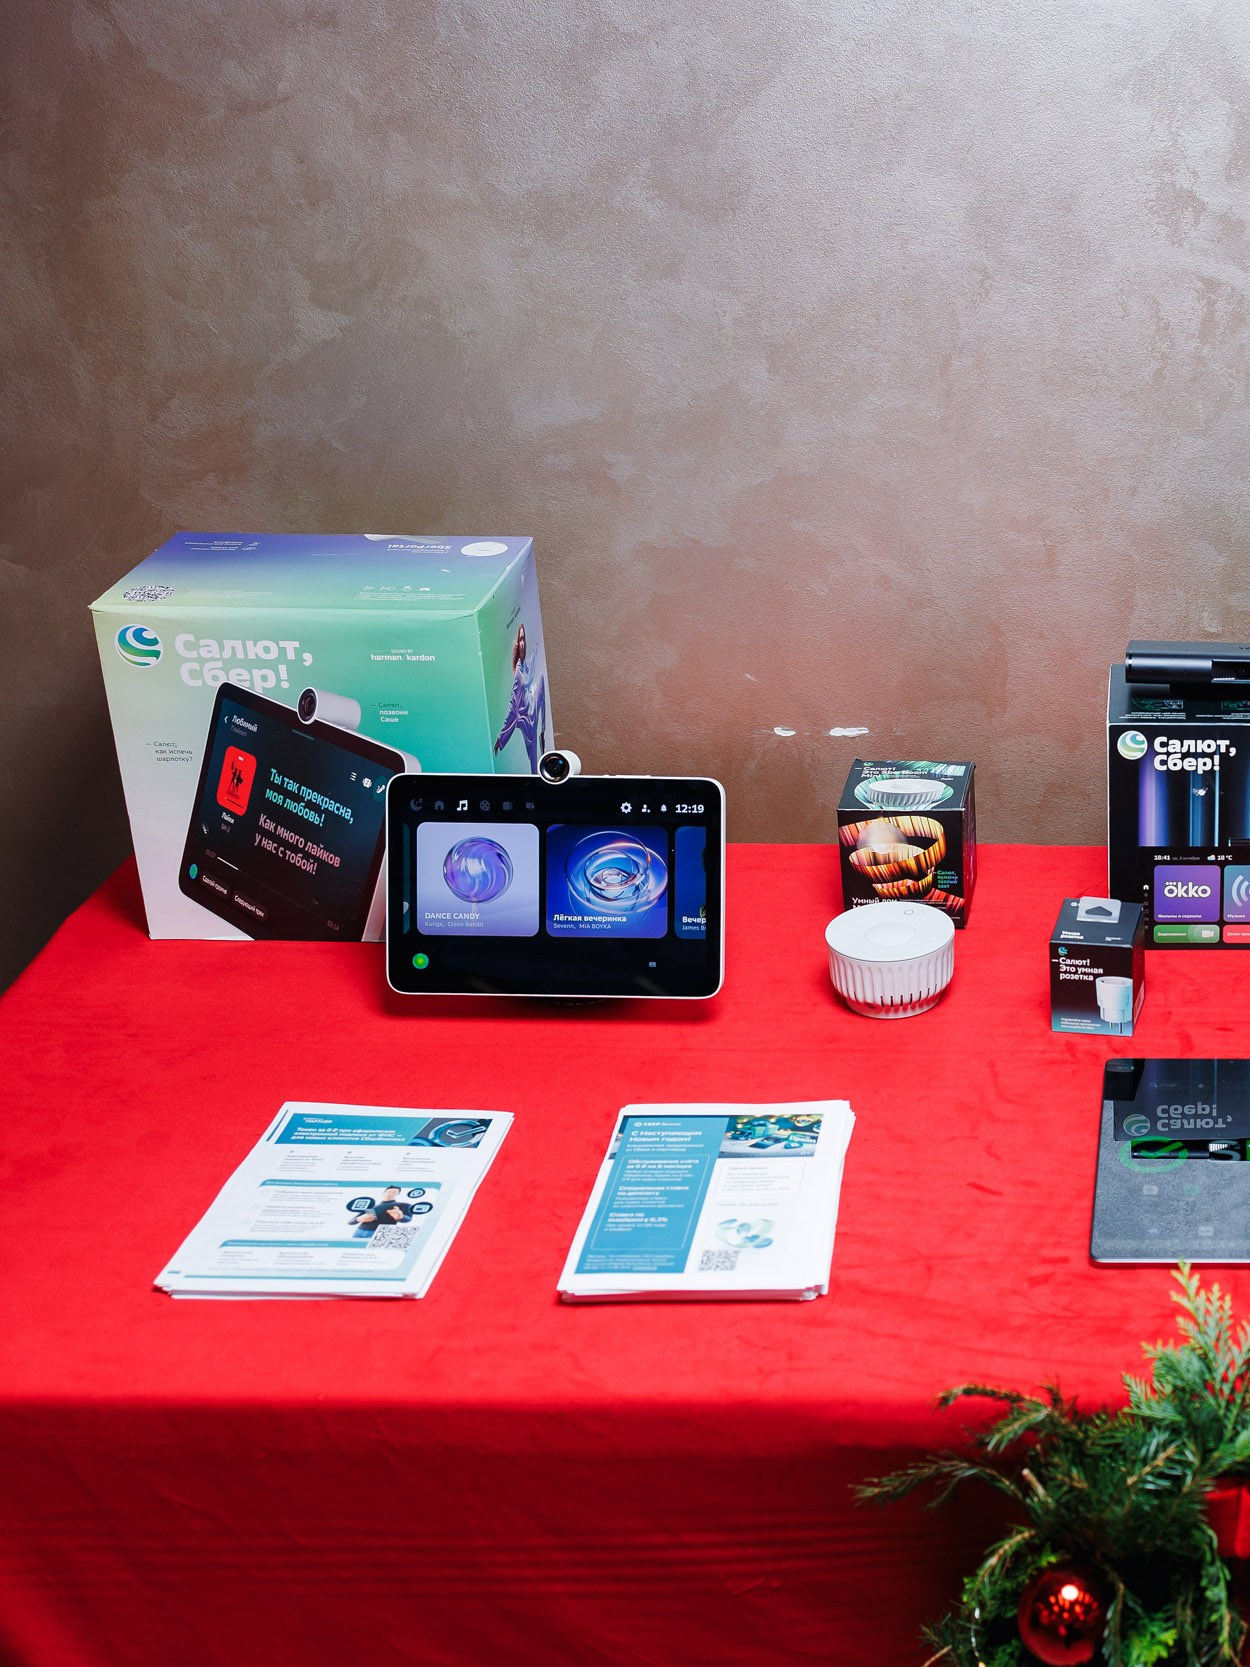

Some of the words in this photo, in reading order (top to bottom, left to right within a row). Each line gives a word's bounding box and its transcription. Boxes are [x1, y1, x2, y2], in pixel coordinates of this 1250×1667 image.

[174, 633, 313, 667] Салют,
[179, 661, 290, 693] Сбер!
[231, 715, 258, 733] Любимый
[1153, 736, 1237, 757] Салют,
[1153, 753, 1220, 774] Сбер!
[270, 768, 282, 786] Ты
[283, 777, 300, 794] так
[299, 785, 354, 825] прекрасна,
[265, 788, 284, 806] моя
[283, 797, 325, 827] любовь!
[675, 803, 705, 814] 12:19
[258, 813, 276, 833] Как
[276, 826, 305, 849] много
[305, 841, 341, 868] лайков
[254, 833, 261, 846] у
[261, 836, 277, 854] нас
[278, 847, 285, 858] с
[285, 850, 318, 875] тобой!
[424, 912, 451, 920] DANCE
[553, 914, 582, 924] Лёгкая
[583, 916, 627, 924] вечеринка
[1059, 957, 1091, 966] Салют!
[1059, 964, 1076, 973] Это
[1077, 966, 1104, 974] умная
[1059, 973, 1094, 981] розетка
